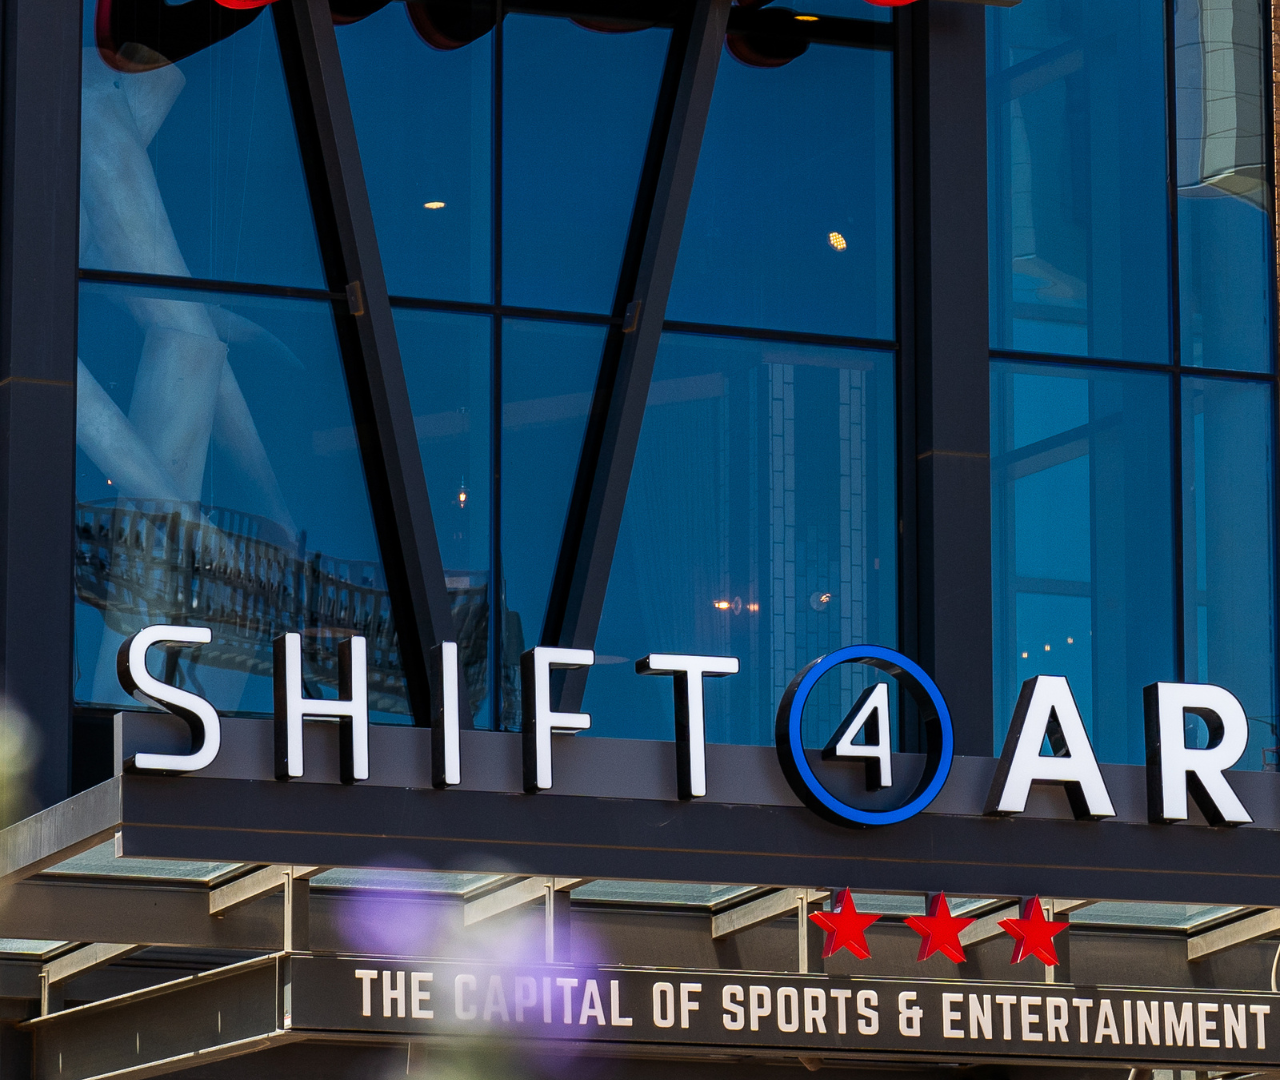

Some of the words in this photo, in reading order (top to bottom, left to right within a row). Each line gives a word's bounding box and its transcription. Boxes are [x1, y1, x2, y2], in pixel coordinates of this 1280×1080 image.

[116, 624, 741, 801] SHIFT
[822, 682, 894, 791] 4
[354, 969, 435, 1020] THE
[453, 972, 634, 1028] CAPITAL
[653, 981, 702, 1032] OF
[722, 983, 880, 1037] SPORTS
[898, 990, 924, 1039] &
[941, 992, 1272, 1051] ENTERTAINMENT
